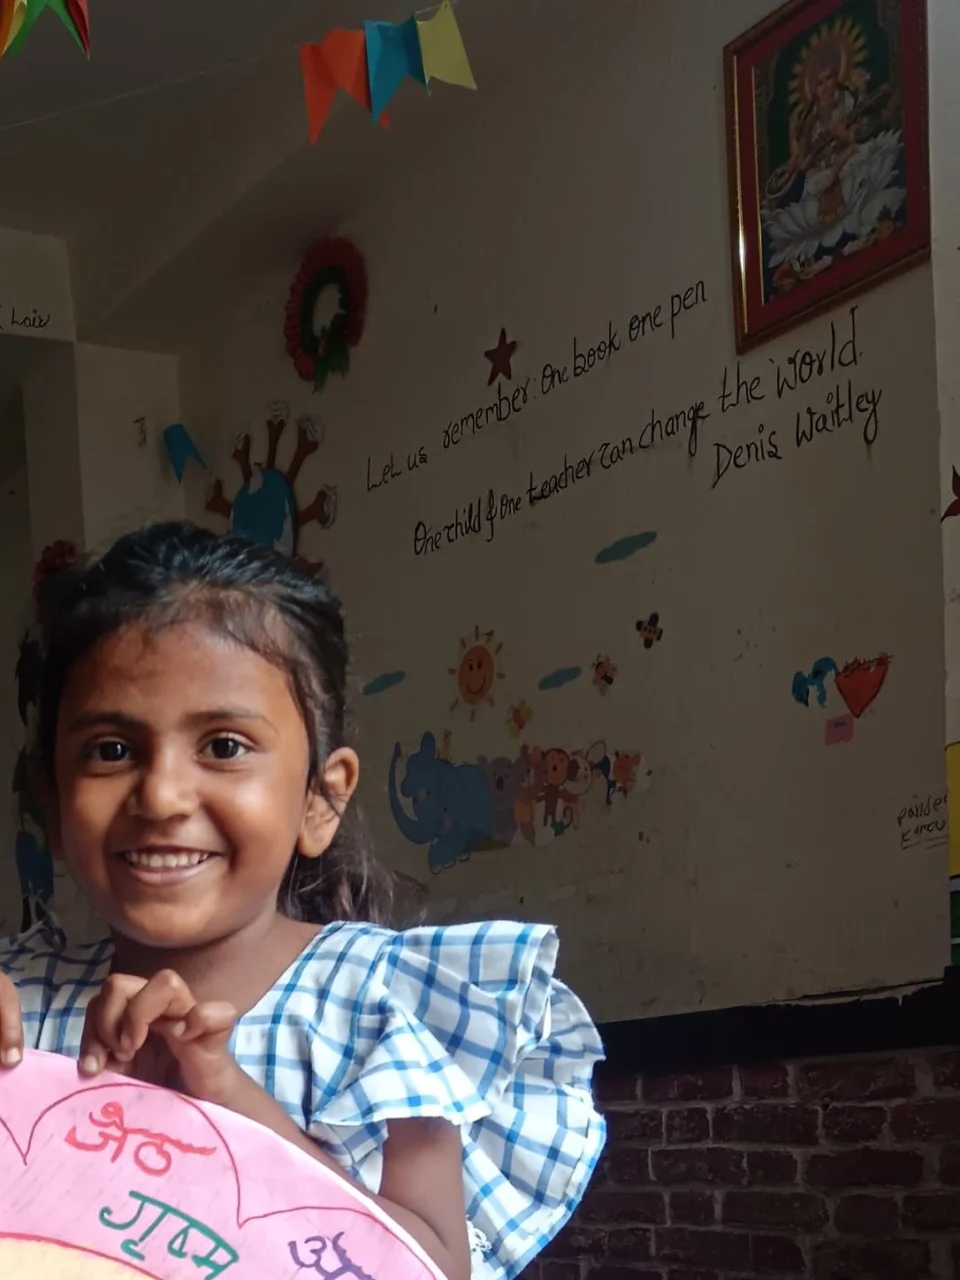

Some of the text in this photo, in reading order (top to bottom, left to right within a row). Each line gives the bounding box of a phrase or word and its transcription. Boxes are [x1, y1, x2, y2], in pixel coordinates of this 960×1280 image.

[367, 453, 402, 492] Let
[407, 446, 428, 470] us
[574, 320, 622, 378] book
[671, 280, 707, 340] pen
[443, 498, 482, 543] child
[527, 453, 593, 508] teacher
[598, 435, 634, 469] can
[639, 401, 711, 457] change
[719, 361, 766, 413] the
[712, 380, 882, 489] Denis Waitley
